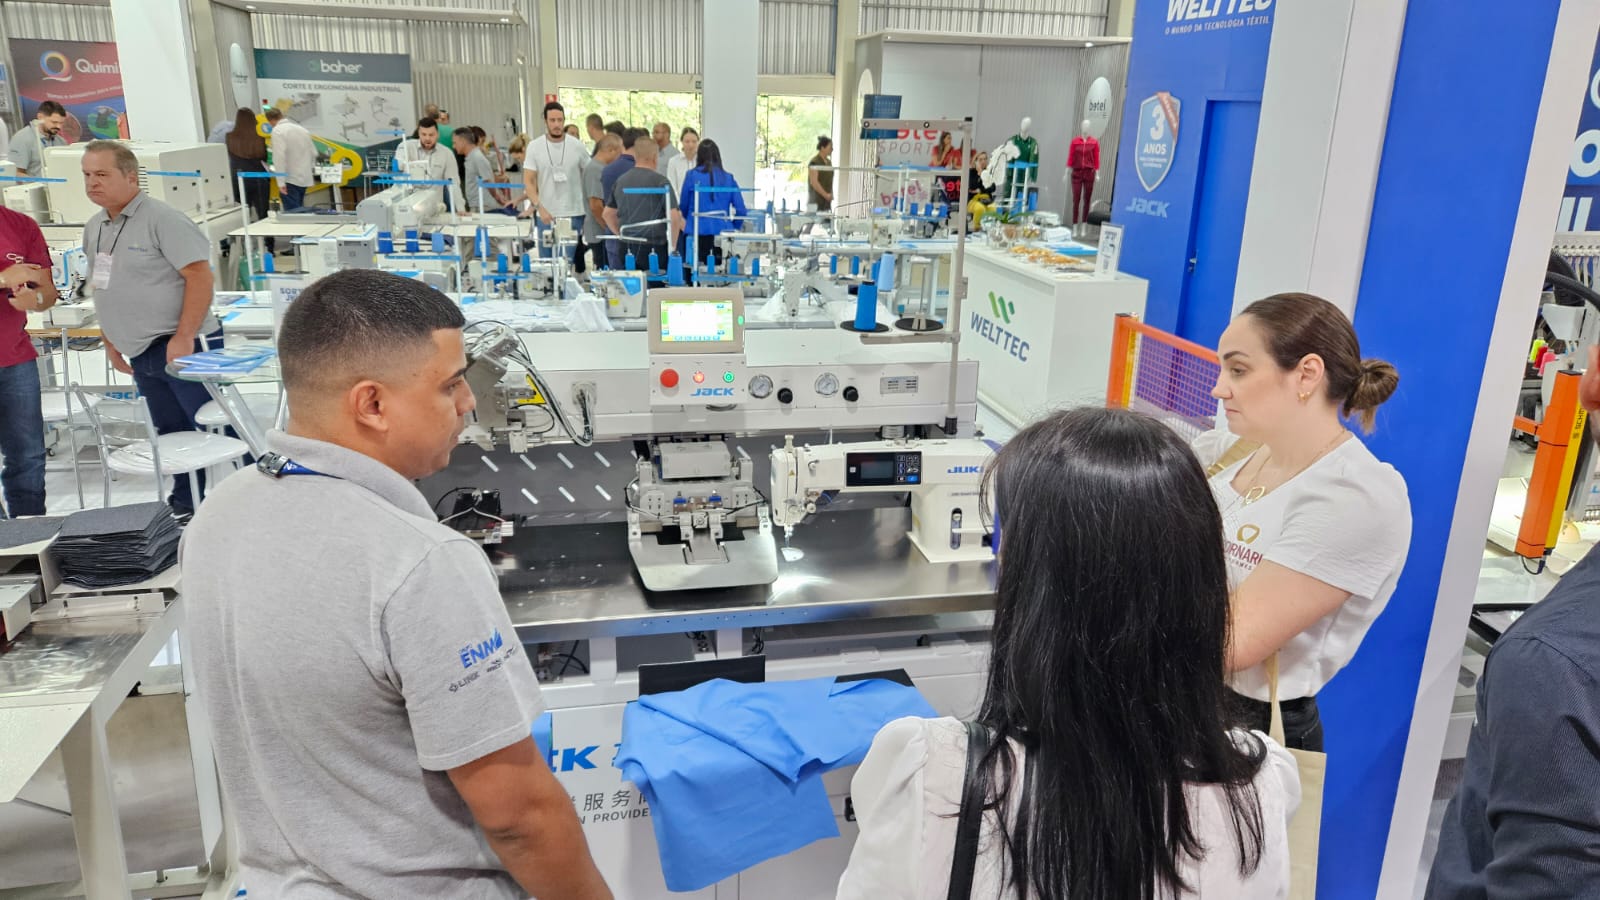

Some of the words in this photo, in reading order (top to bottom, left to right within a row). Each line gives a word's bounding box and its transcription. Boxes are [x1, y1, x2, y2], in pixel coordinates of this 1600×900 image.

[1171, 25, 1192, 34] MUNDO
[1194, 23, 1202, 32] DA
[1204, 18, 1244, 31] TECNOLOGIA
[75, 58, 120, 74] Quimi
[282, 82, 306, 90] CORTE
[1150, 104, 1165, 140] 3
[1143, 143, 1167, 155] ANOS
[971, 311, 1030, 362] WELTTEC
[1574, 407, 1585, 431] SCHM
[1224, 540, 1263, 566] ORNARI
[578, 790, 640, 811] 服务
[593, 807, 650, 823] PROVIDE
